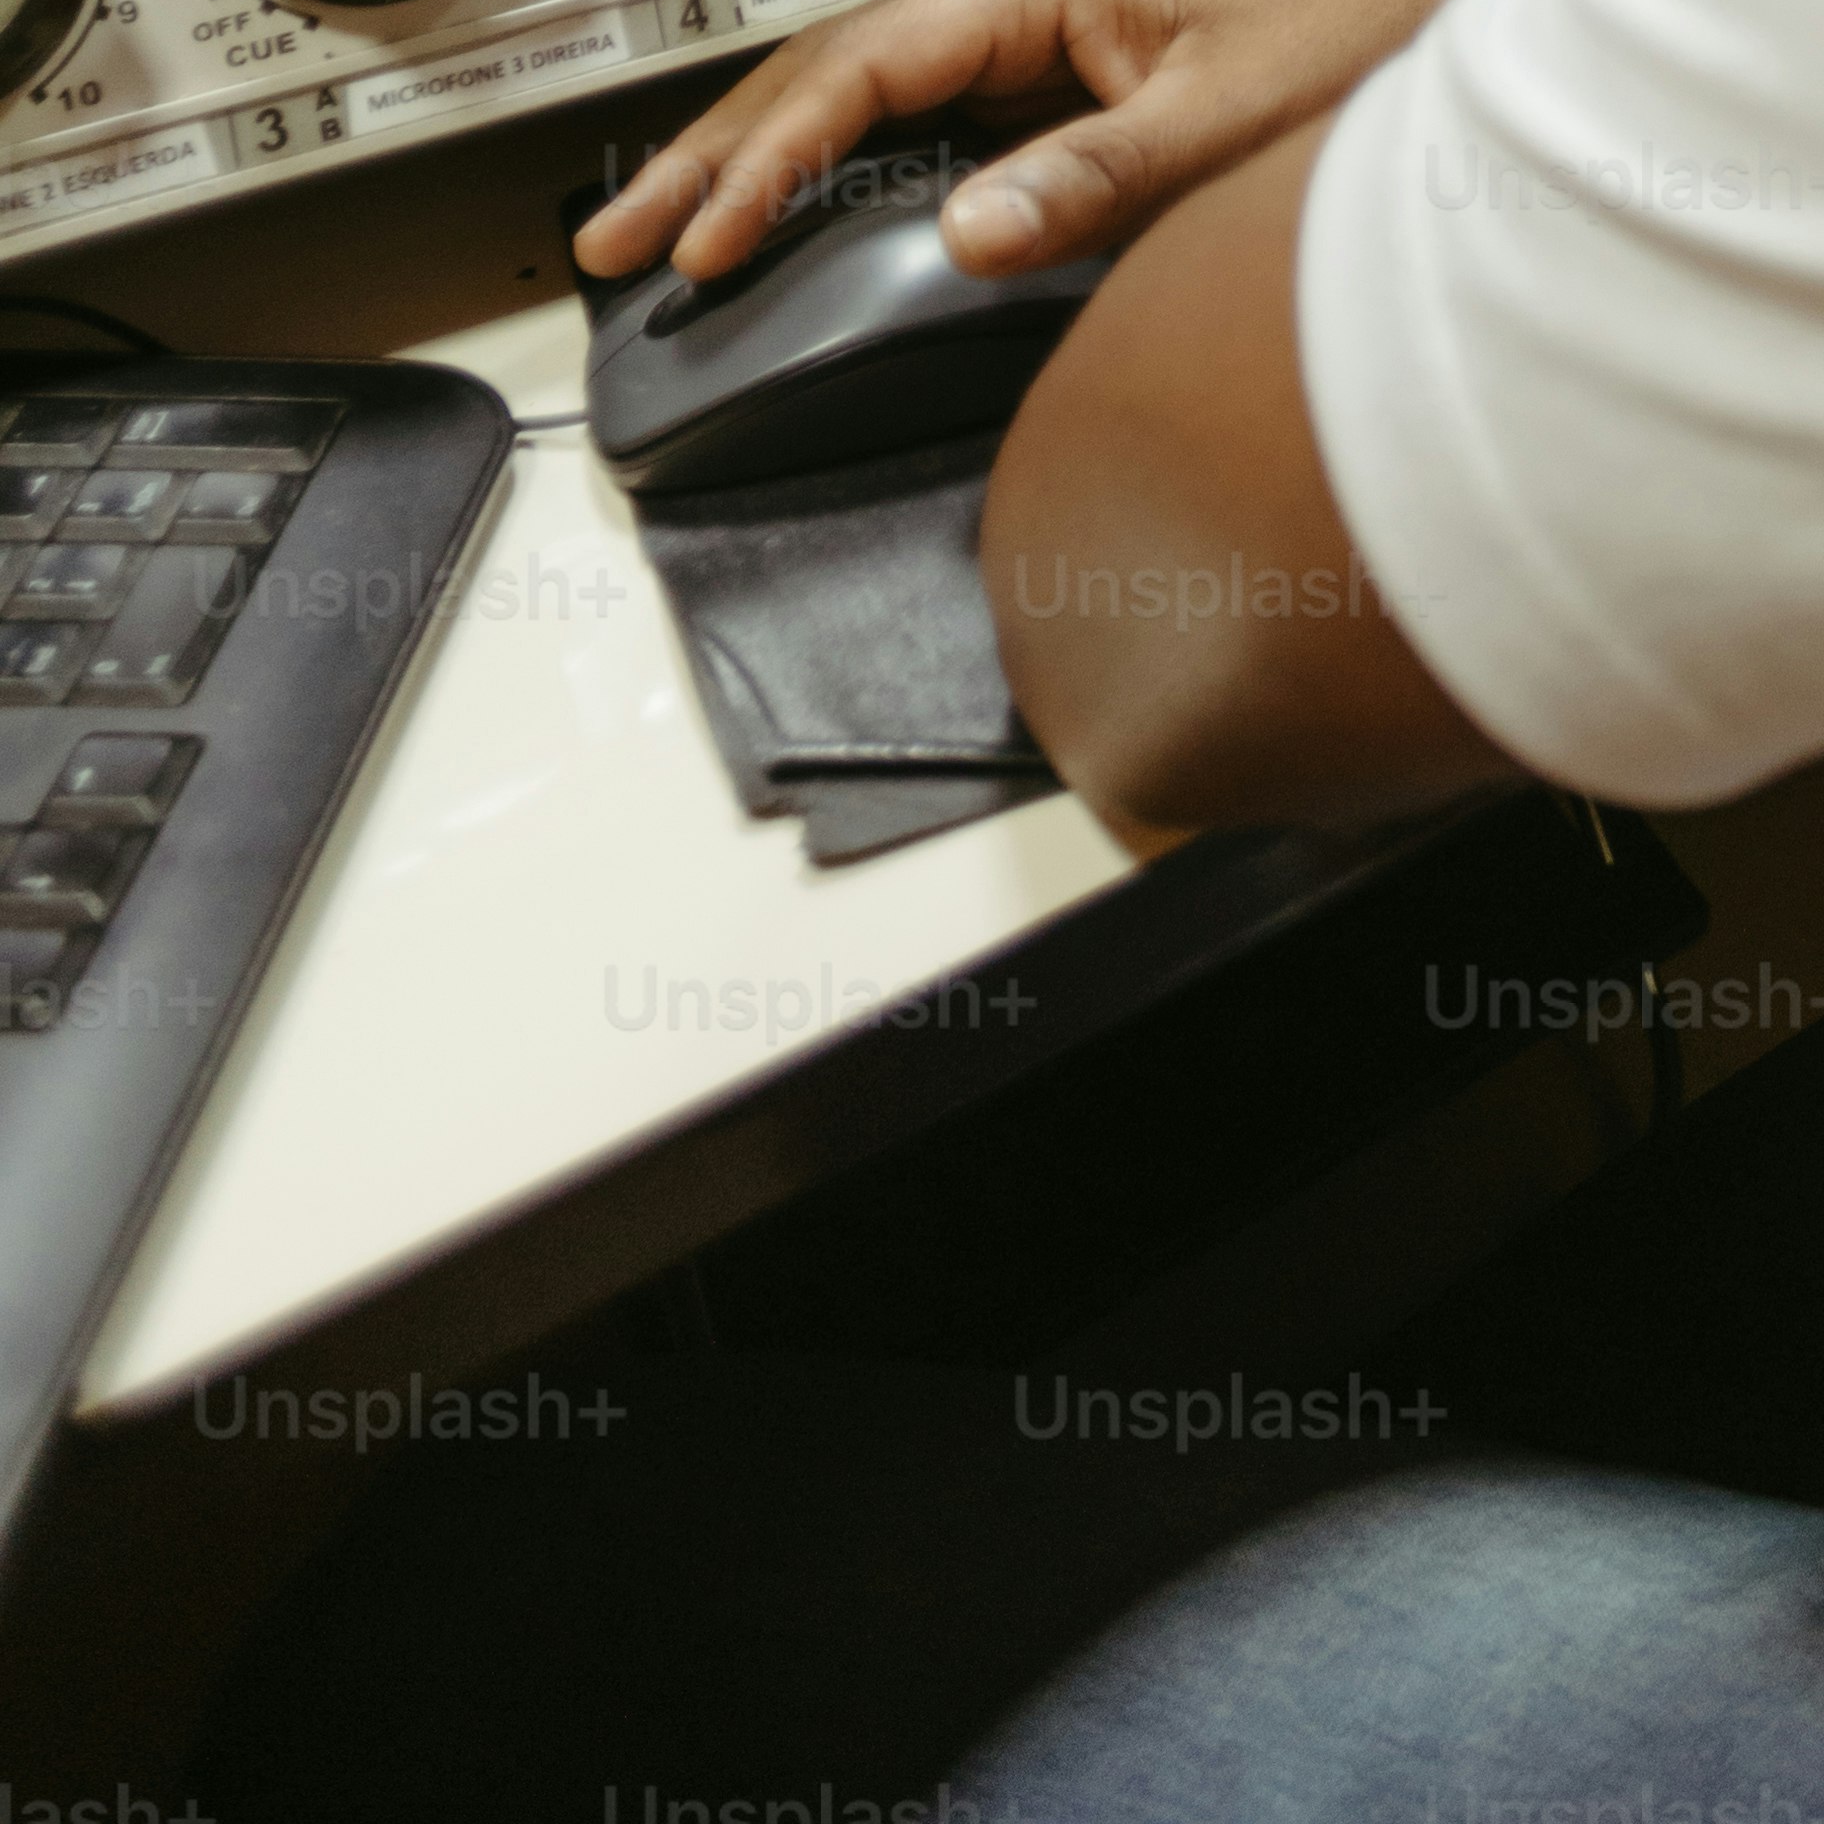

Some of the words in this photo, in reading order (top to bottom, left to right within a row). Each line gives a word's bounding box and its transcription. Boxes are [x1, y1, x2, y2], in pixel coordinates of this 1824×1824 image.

[193, 9, 250, 42] OFF
[225, 32, 297, 66] CUE
[315, 85, 339, 110] A
[366, 61, 506, 114] MICROFONE
[508, 56, 525, 77] 3
[255, 110, 289, 152] 3
[320, 117, 342, 144] B
